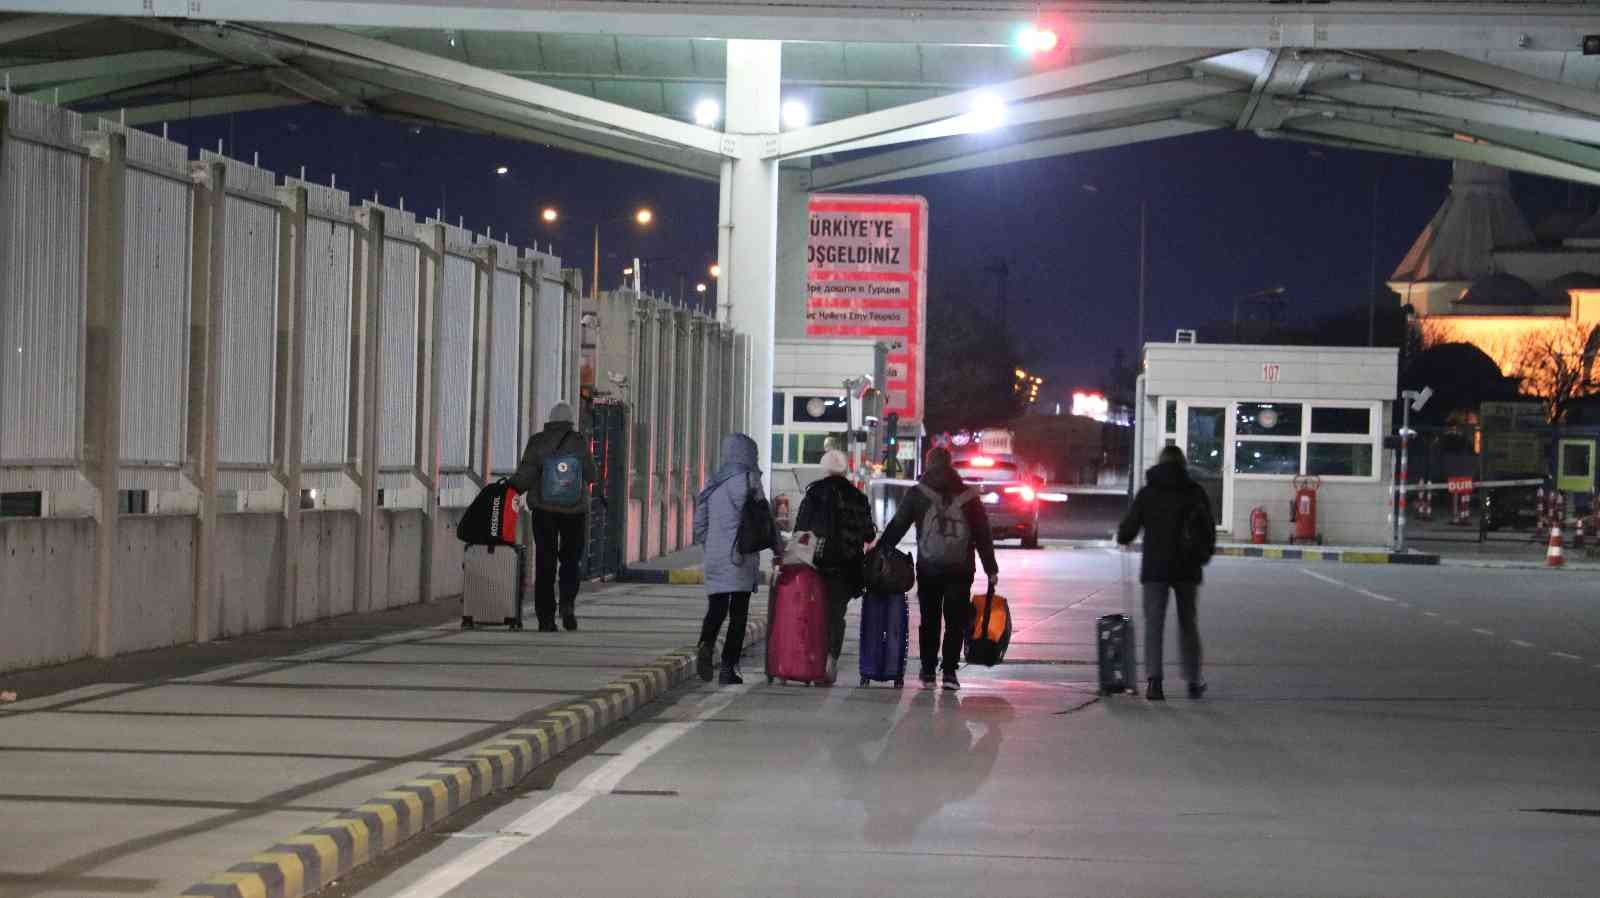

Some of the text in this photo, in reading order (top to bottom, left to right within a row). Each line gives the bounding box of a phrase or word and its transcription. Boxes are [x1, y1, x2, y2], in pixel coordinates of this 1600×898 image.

[809, 214, 894, 238] ÜRKİYE'YE
[807, 242, 900, 268] OŞGELDİNİZ
[1263, 364, 1280, 381] 107
